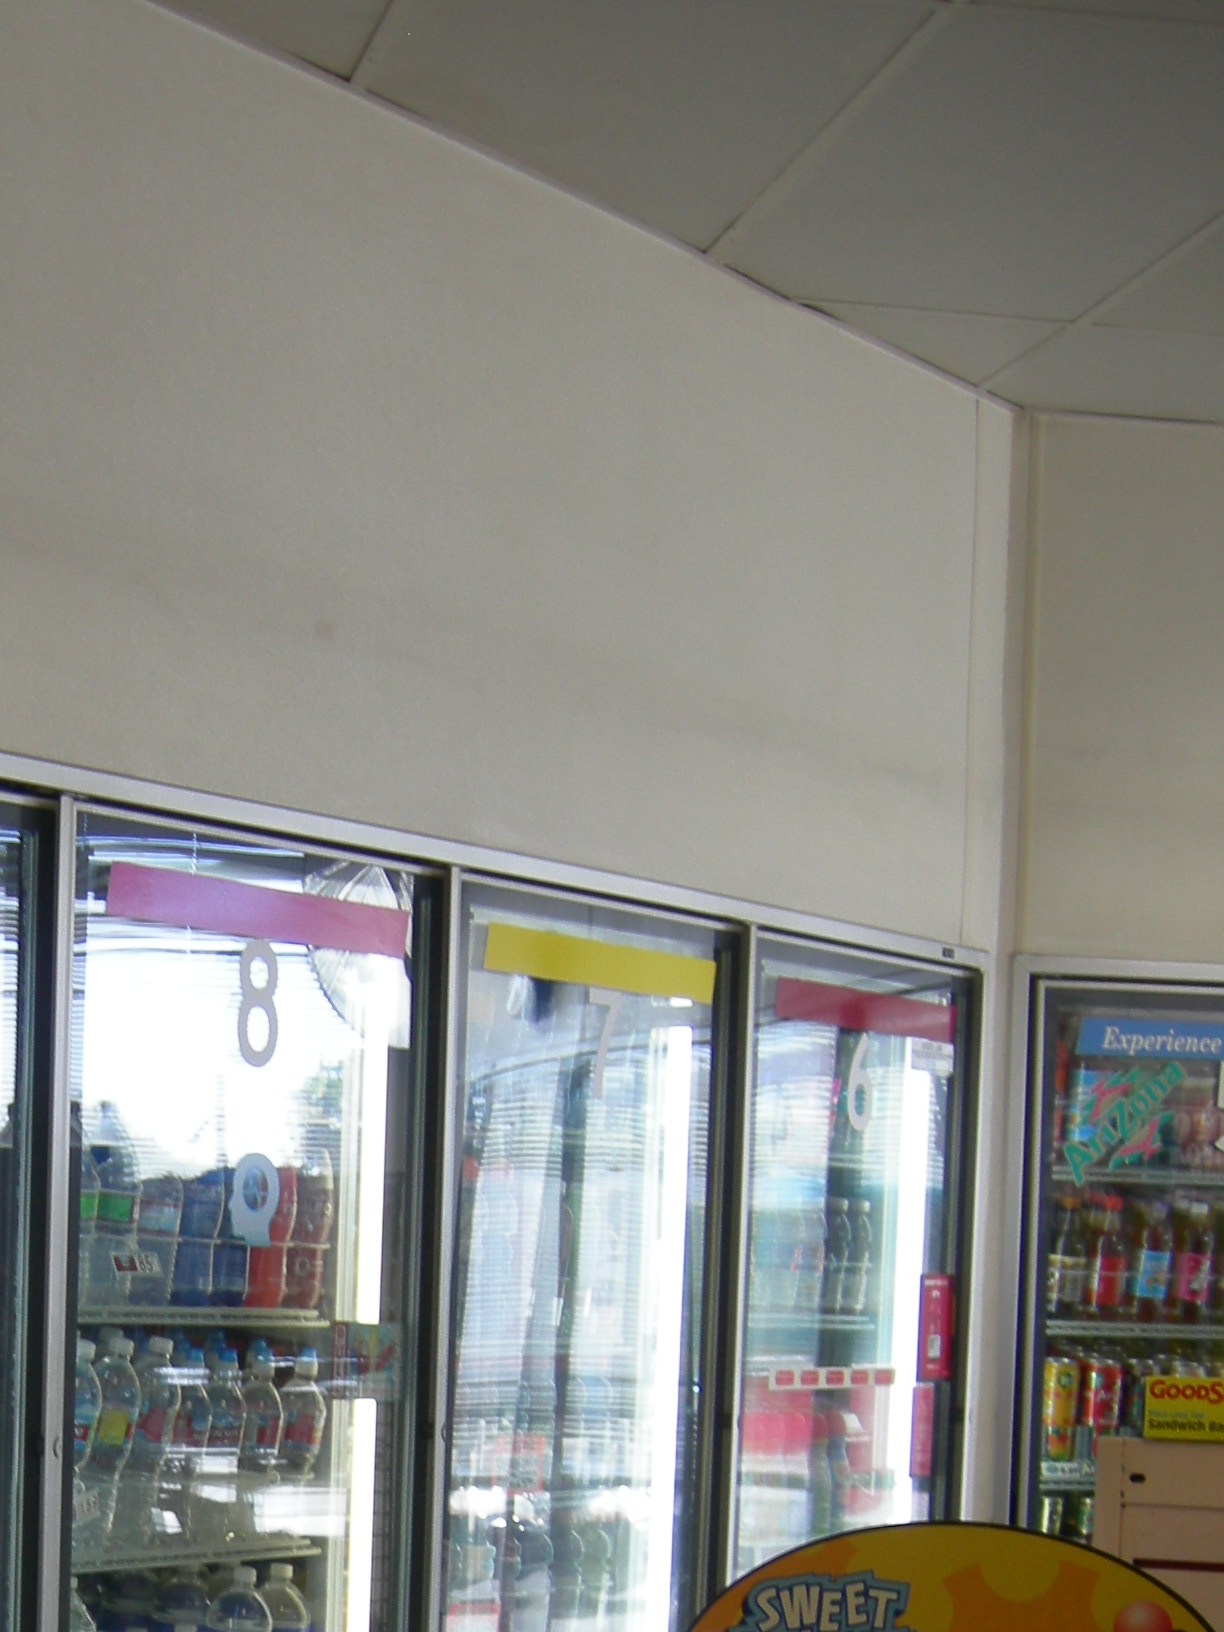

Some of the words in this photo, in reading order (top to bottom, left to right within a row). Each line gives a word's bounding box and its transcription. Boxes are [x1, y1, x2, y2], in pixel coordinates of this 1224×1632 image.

[238, 938, 278, 1068] 8
[1102, 1026, 1222, 1056] Experience
[847, 1033, 873, 1131] 6
[1149, 1418, 1205, 1431] Sandwich
[757, 1580, 899, 1632] SWEET
